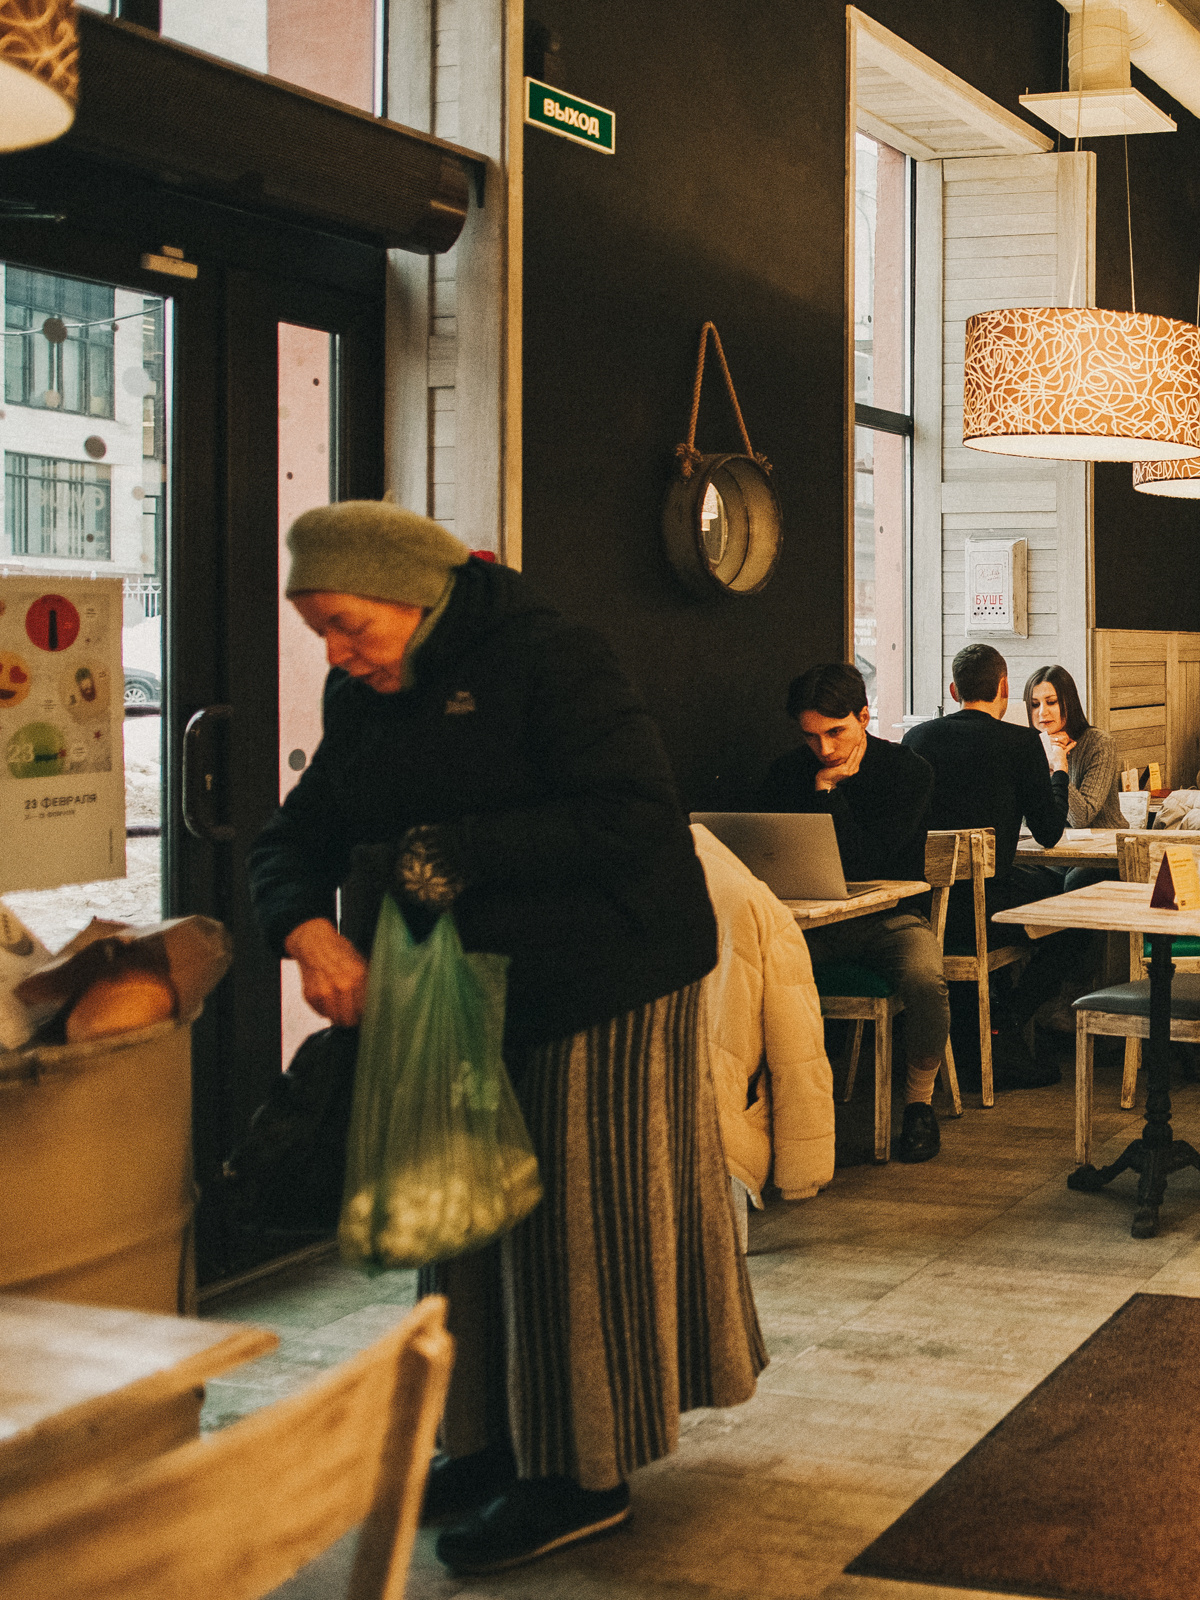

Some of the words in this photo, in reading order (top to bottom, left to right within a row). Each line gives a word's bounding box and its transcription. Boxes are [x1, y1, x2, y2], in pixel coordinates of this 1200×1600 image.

[543, 98, 600, 138] ВЫХОД
[976, 594, 1003, 605] БУШЕ
[24, 799, 37, 809] 23
[41, 794, 97, 808] ФЕВРАЛЯ
